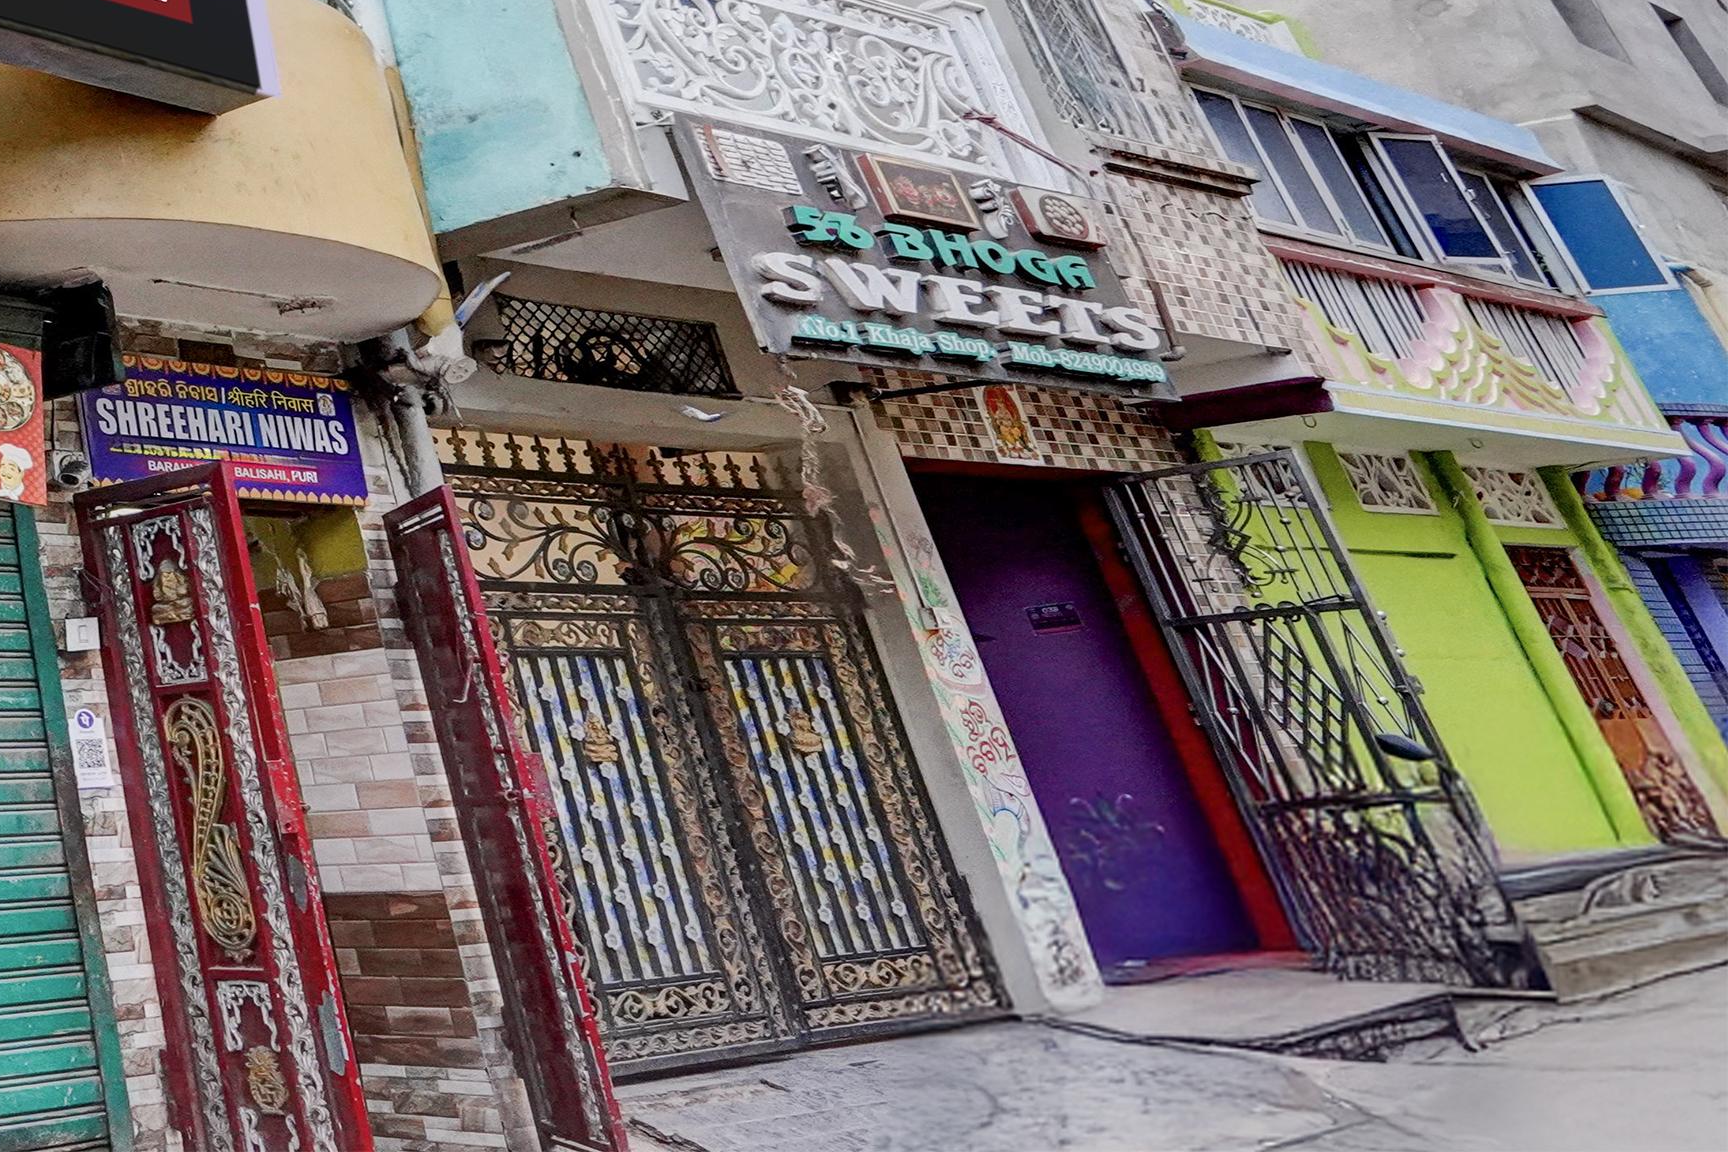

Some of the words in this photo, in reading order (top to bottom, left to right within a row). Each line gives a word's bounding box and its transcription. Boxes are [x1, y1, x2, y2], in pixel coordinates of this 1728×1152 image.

[786, 204, 875, 250] 56
[874, 222, 1097, 289] BHOGA
[755, 251, 1161, 350] SWEETS
[800, 315, 860, 342] No.1
[868, 323, 933, 355] Khaja
[937, 332, 997, 362] Shop.
[95, 397, 255, 447] SHREEHARI
[257, 410, 349, 455] NIWAS
[227, 387, 268, 409] श्रीहरि
[271, 391, 315, 414] निवास
[234, 466, 290, 484] BALISAHI,
[291, 470, 318, 484] PURI
